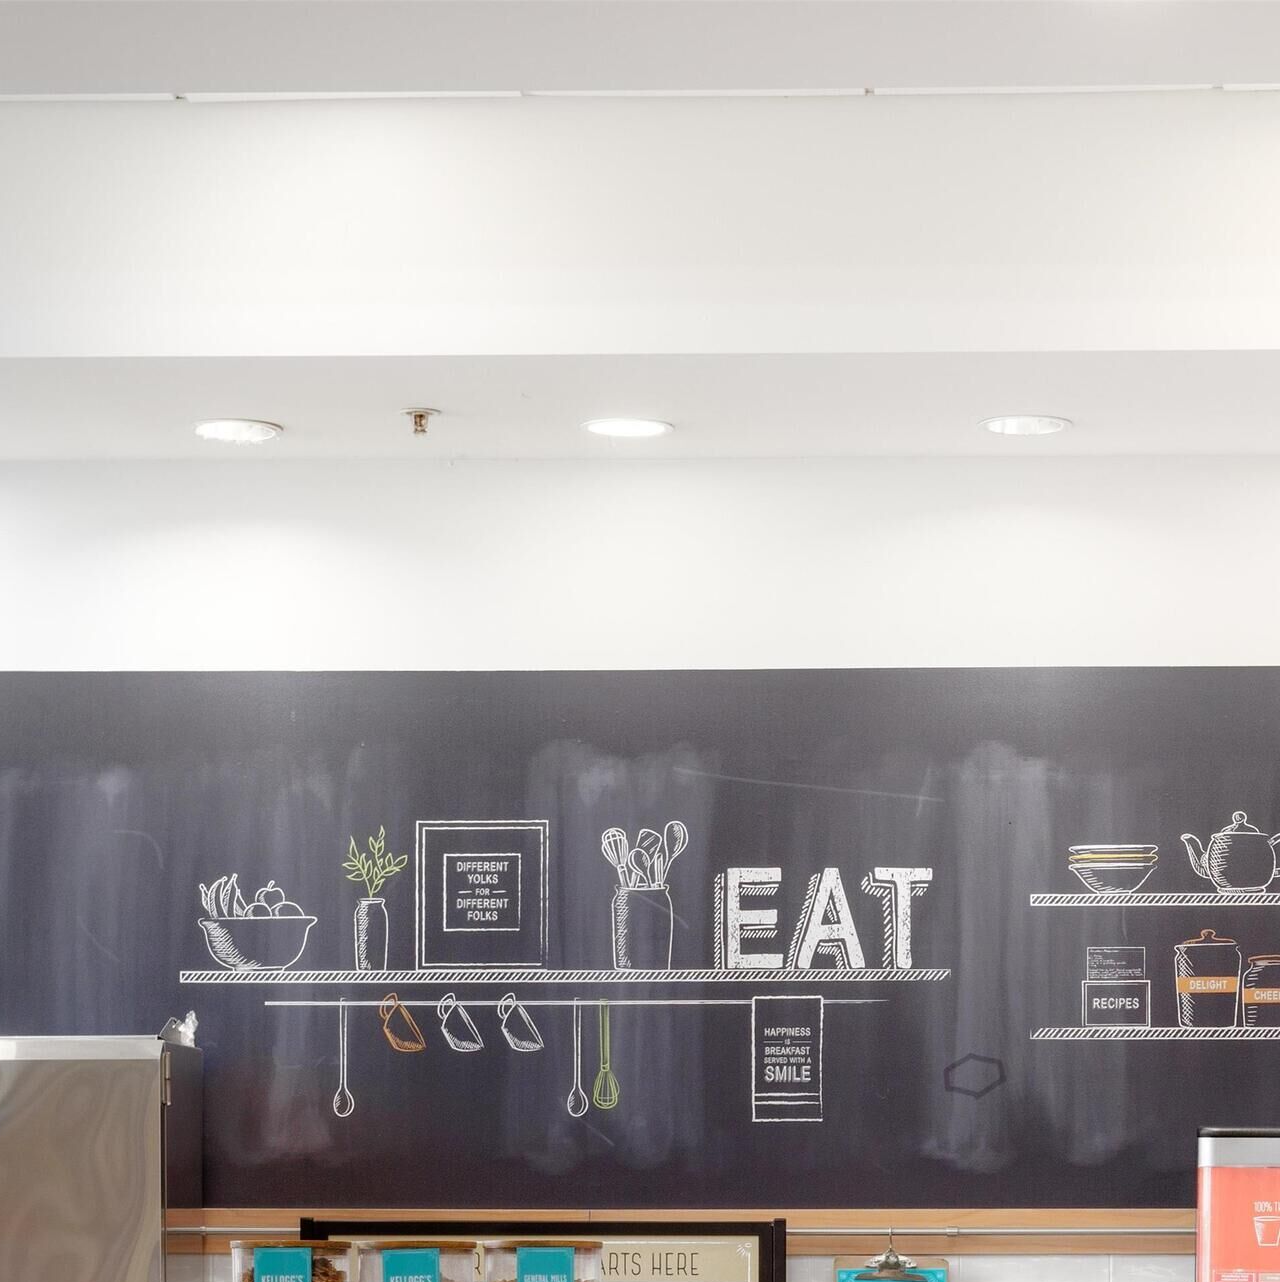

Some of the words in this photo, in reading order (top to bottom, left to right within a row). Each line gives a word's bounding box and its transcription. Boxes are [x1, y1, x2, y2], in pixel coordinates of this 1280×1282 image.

[456, 861, 509, 872] DIFFERENT
[467, 874, 499, 884] YOLKS
[475, 888, 490, 896] FOR
[456, 898, 509, 909] DIFFERENT
[467, 911, 498, 921] FOLKS
[715, 867, 933, 969] EAT
[1189, 980, 1227, 990] DELIGHT
[1092, 998, 1140, 1009] RECIPES
[764, 1027, 811, 1037] HAPPINESS
[764, 1046, 811, 1055] BREAKFAST
[764, 1056, 788, 1064] SERVED
[789, 1056, 805, 1064] WITH
[807, 1056, 812, 1064] A
[764, 1065, 812, 1083] SMILE
[1253, 1201, 1273, 1213] 100%
[651, 1252, 699, 1276] HERE
